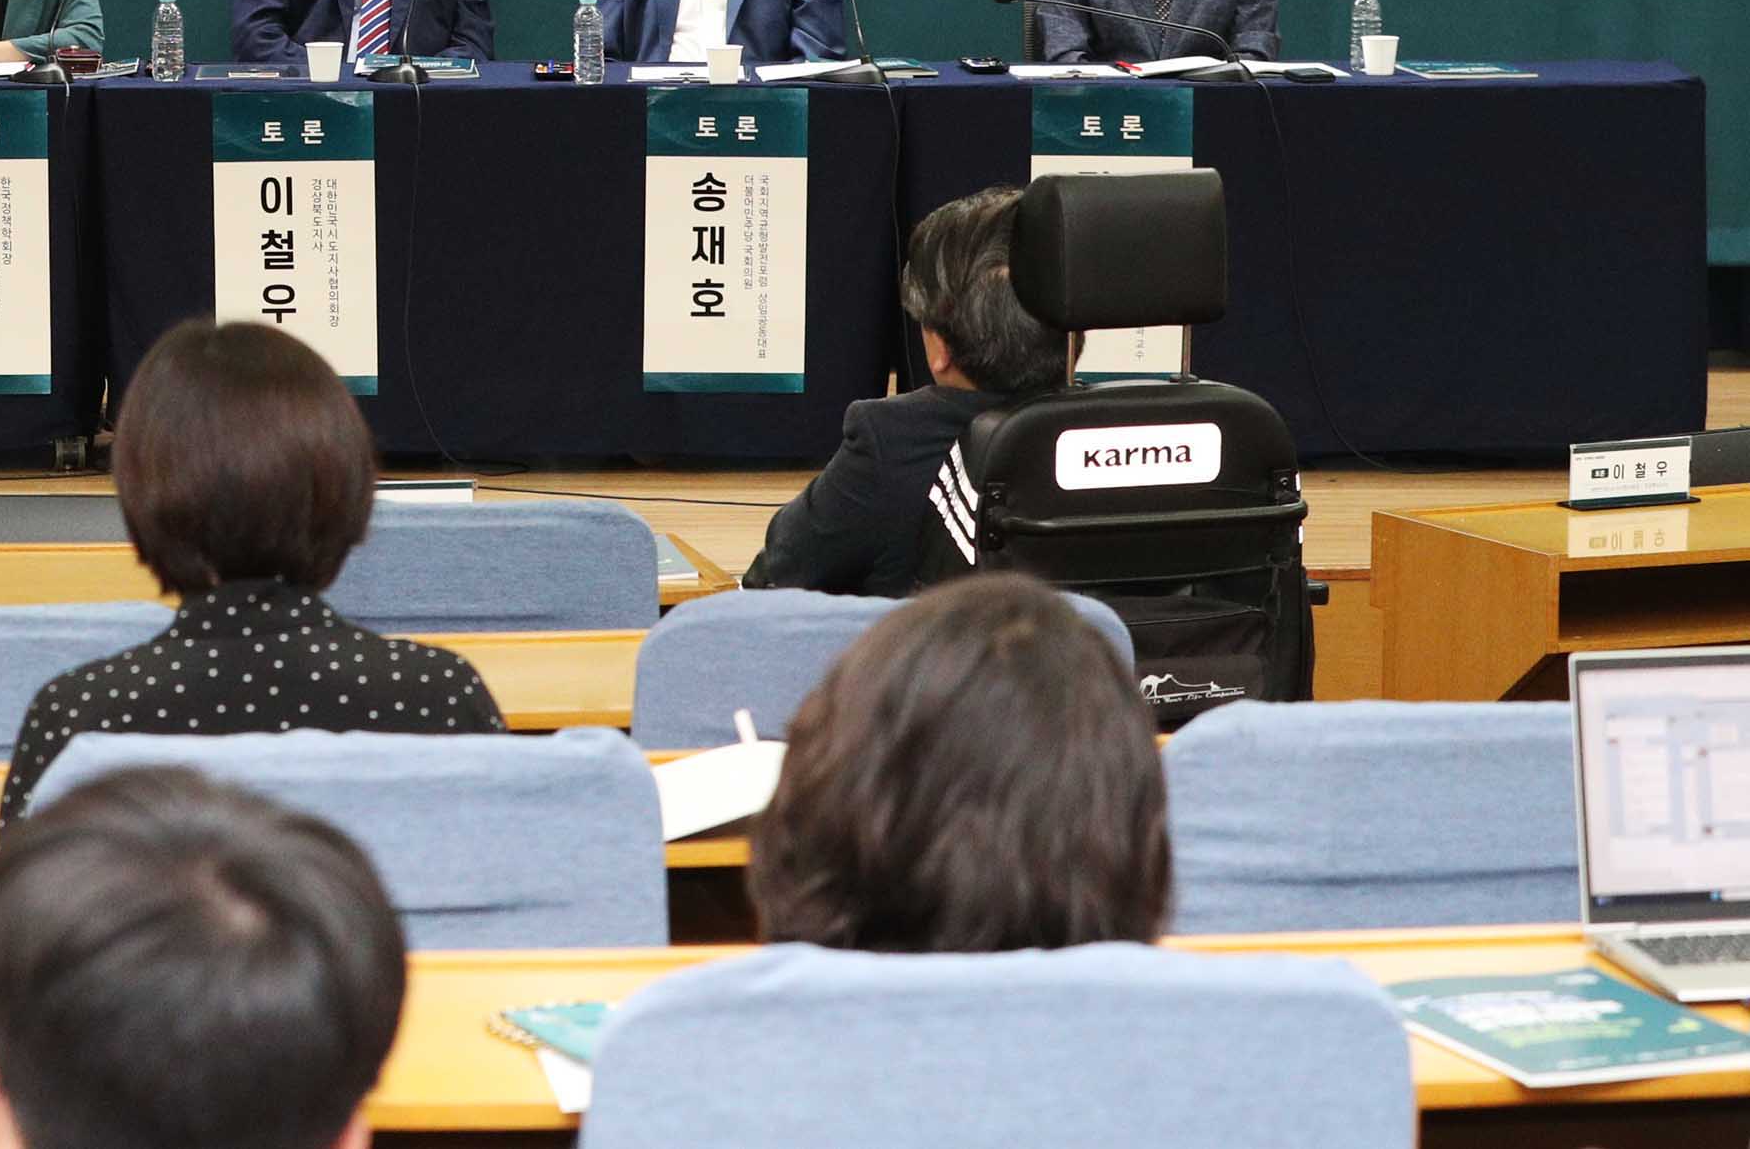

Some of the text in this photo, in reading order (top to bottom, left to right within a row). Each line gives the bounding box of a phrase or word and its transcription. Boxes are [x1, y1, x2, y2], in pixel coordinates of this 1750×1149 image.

[261, 120, 325, 145] 토론
[695, 115, 759, 141] 토론
[1080, 115, 1144, 140] 토론
[0, 176, 13, 266] 한국정책학회장
[260, 176, 297, 324] 이철우
[311, 178, 323, 253] 경상북도지사
[326, 178, 340, 328] 대한민국시도지사협의회장
[690, 172, 727, 317] 송재호
[1613, 460, 1669, 480] 이철우
